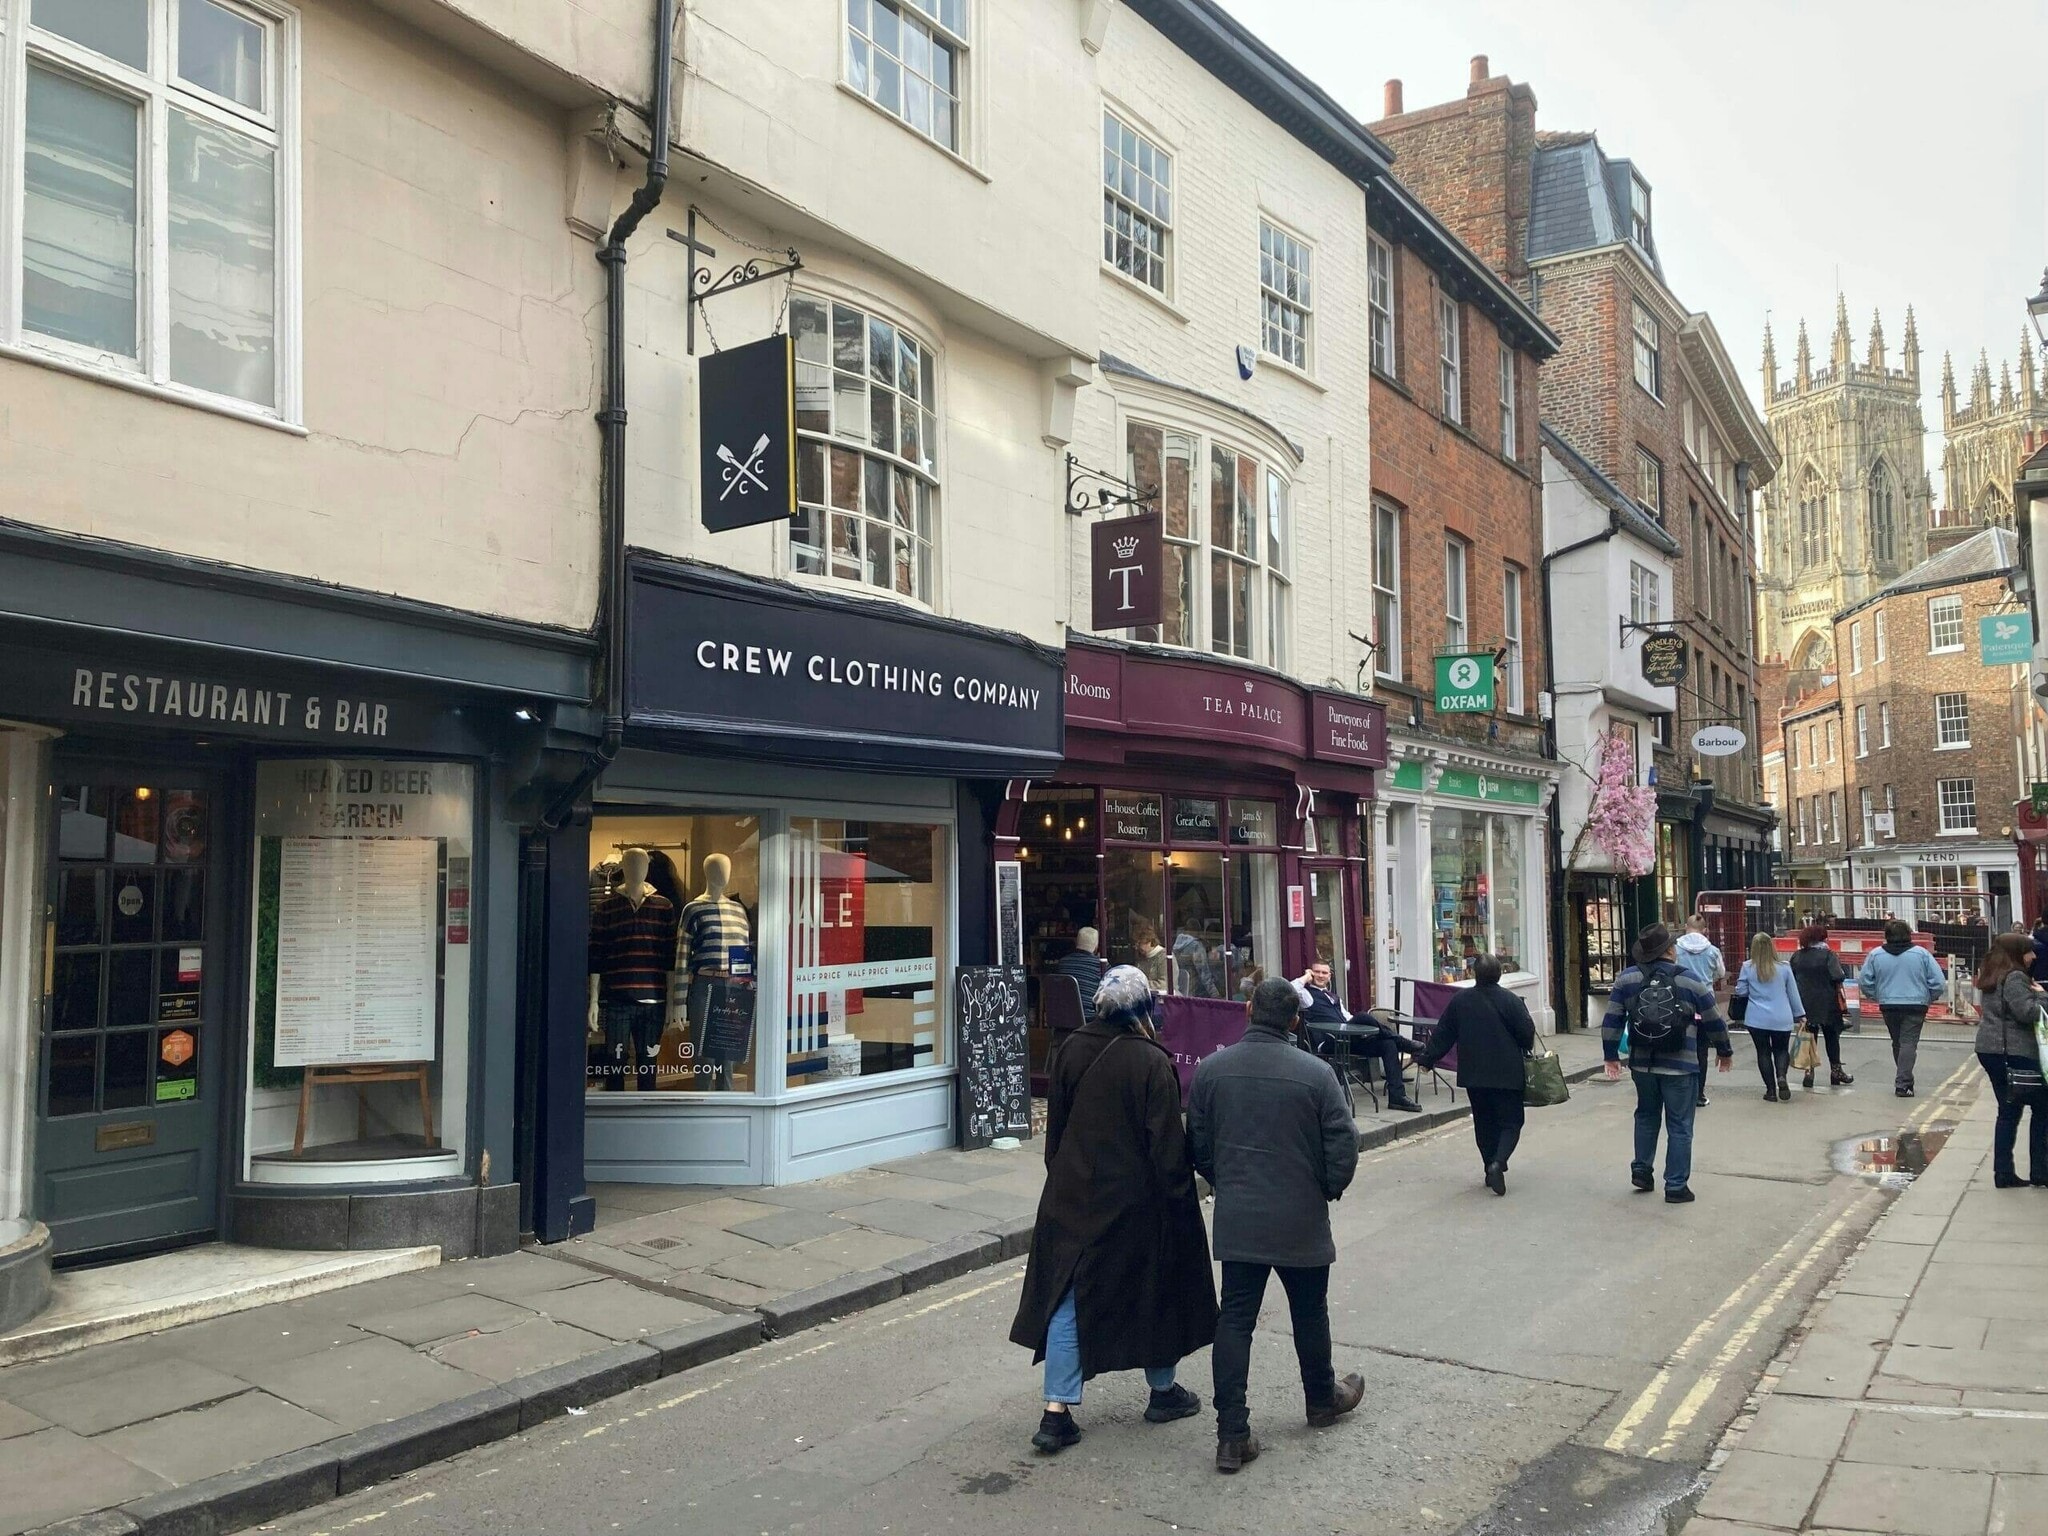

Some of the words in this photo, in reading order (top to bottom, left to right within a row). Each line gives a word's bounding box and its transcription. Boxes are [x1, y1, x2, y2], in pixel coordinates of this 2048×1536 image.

[1108, 564, 1144, 610] T
[697, 640, 793, 677] CREW
[807, 655, 942, 697] CLOTHING
[953, 676, 1040, 711] COMPANY
[1070, 674, 1111, 700] Rooms
[72, 668, 291, 726] RESTAURANT
[305, 696, 321, 730] &
[334, 699, 388, 736] BAR
[1202, 696, 1233, 714] TEA
[1241, 702, 1282, 724] PALACE
[1441, 694, 1487, 709] OXFAM
[1328, 705, 1363, 731] Purveyors
[1362, 712, 1371, 729] of
[1331, 730, 1347, 748] Fine
[1347, 732, 1369, 751] Foods
[1698, 738, 1738, 746] Barbour
[296, 768, 373, 794] HEATED
[380, 769, 432, 795] BEER
[319, 803, 403, 828] GARDEN
[1105, 799, 1136, 815] In-house
[1136, 801, 1160, 817] Coffee
[1241, 808, 1255, 823] Jams
[1117, 820, 1149, 839] Roastery
[1175, 813, 1194, 827] Great
[1195, 815, 1211, 828] Gifts
[1918, 853, 1960, 862] AZENDI
[121, 896, 141, 906] Open
[788, 892, 853, 928] ALE
[796, 973, 816, 982] HALF
[818, 971, 841, 980] PRICE
[847, 969, 866, 978] HALF
[868, 967, 889, 976] PRICE
[894, 965, 911, 974] HALF
[913, 963, 933, 971] PRICE
[1174, 1052, 1201, 1066] TEA
[585, 1064, 723, 1075] CREWCLOTHING.COM
